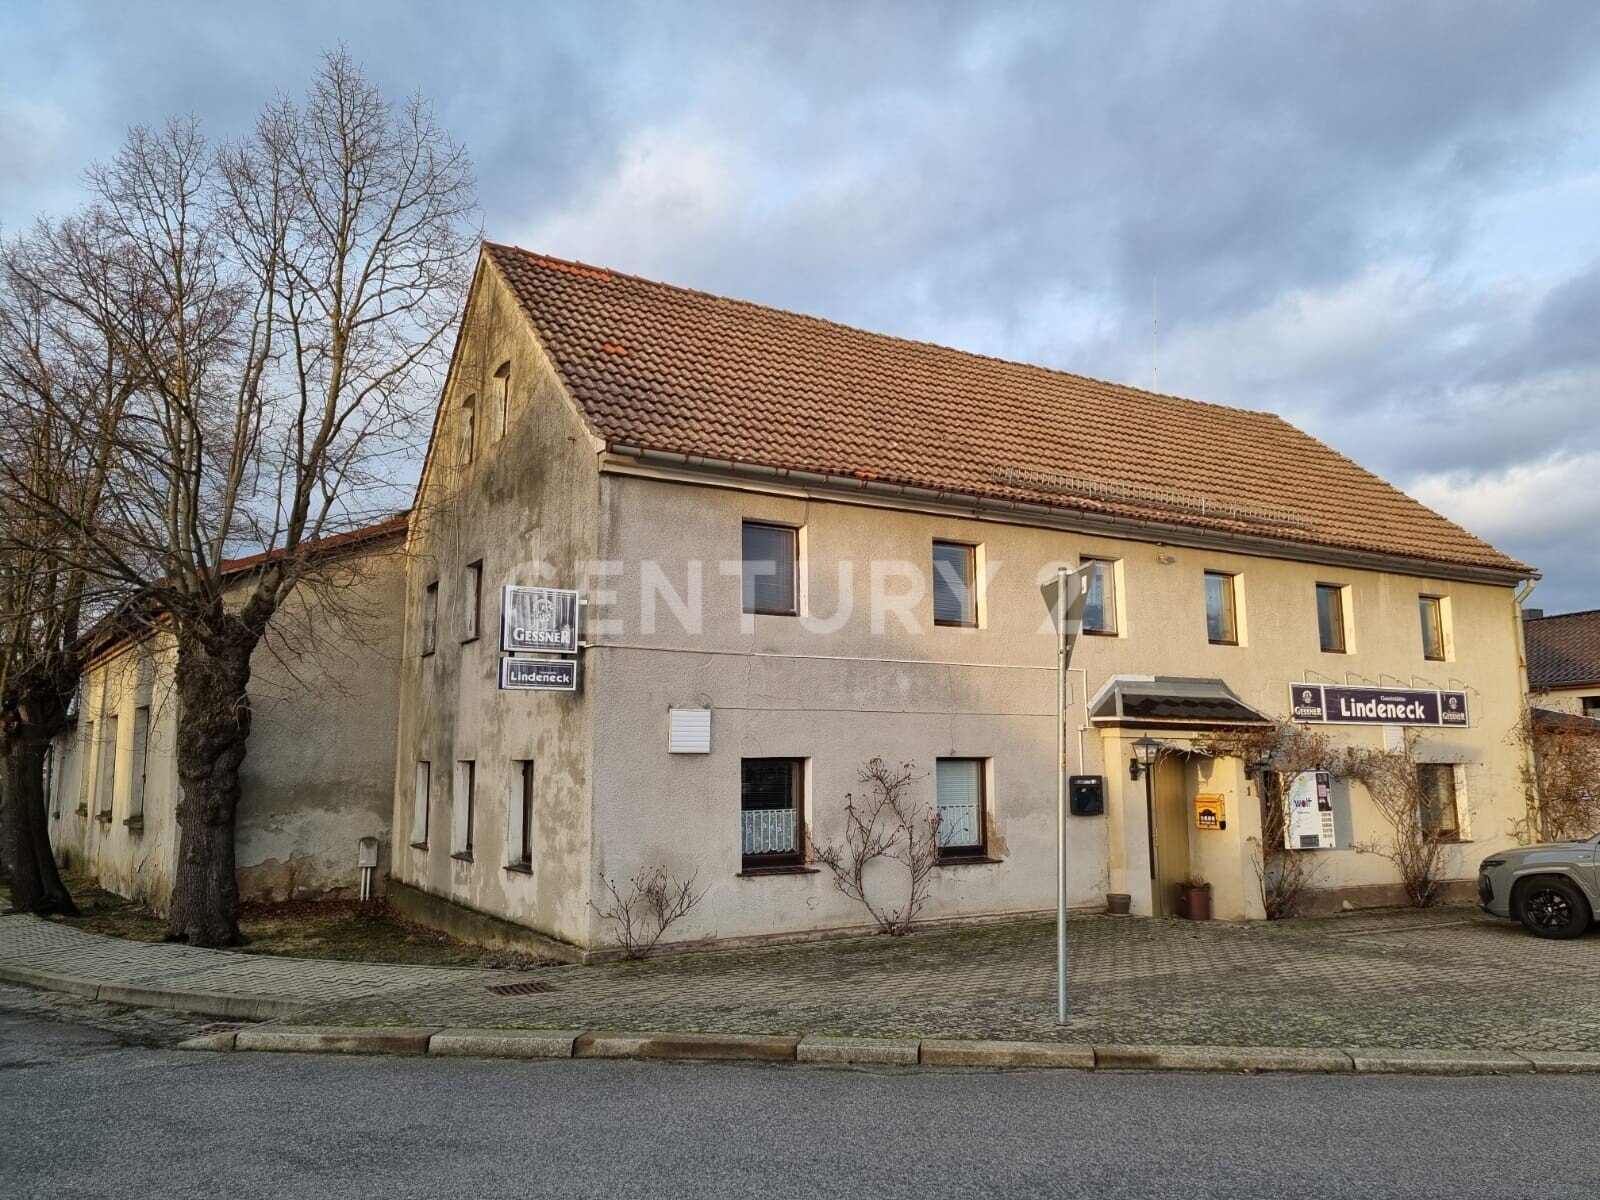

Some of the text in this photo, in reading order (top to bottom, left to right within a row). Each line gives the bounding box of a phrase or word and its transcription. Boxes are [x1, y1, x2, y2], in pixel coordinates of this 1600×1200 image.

[513, 627, 570, 644] GESSNER
[511, 671, 570, 683] Lindeneck
[1340, 698, 1426, 719] Lindeneck
